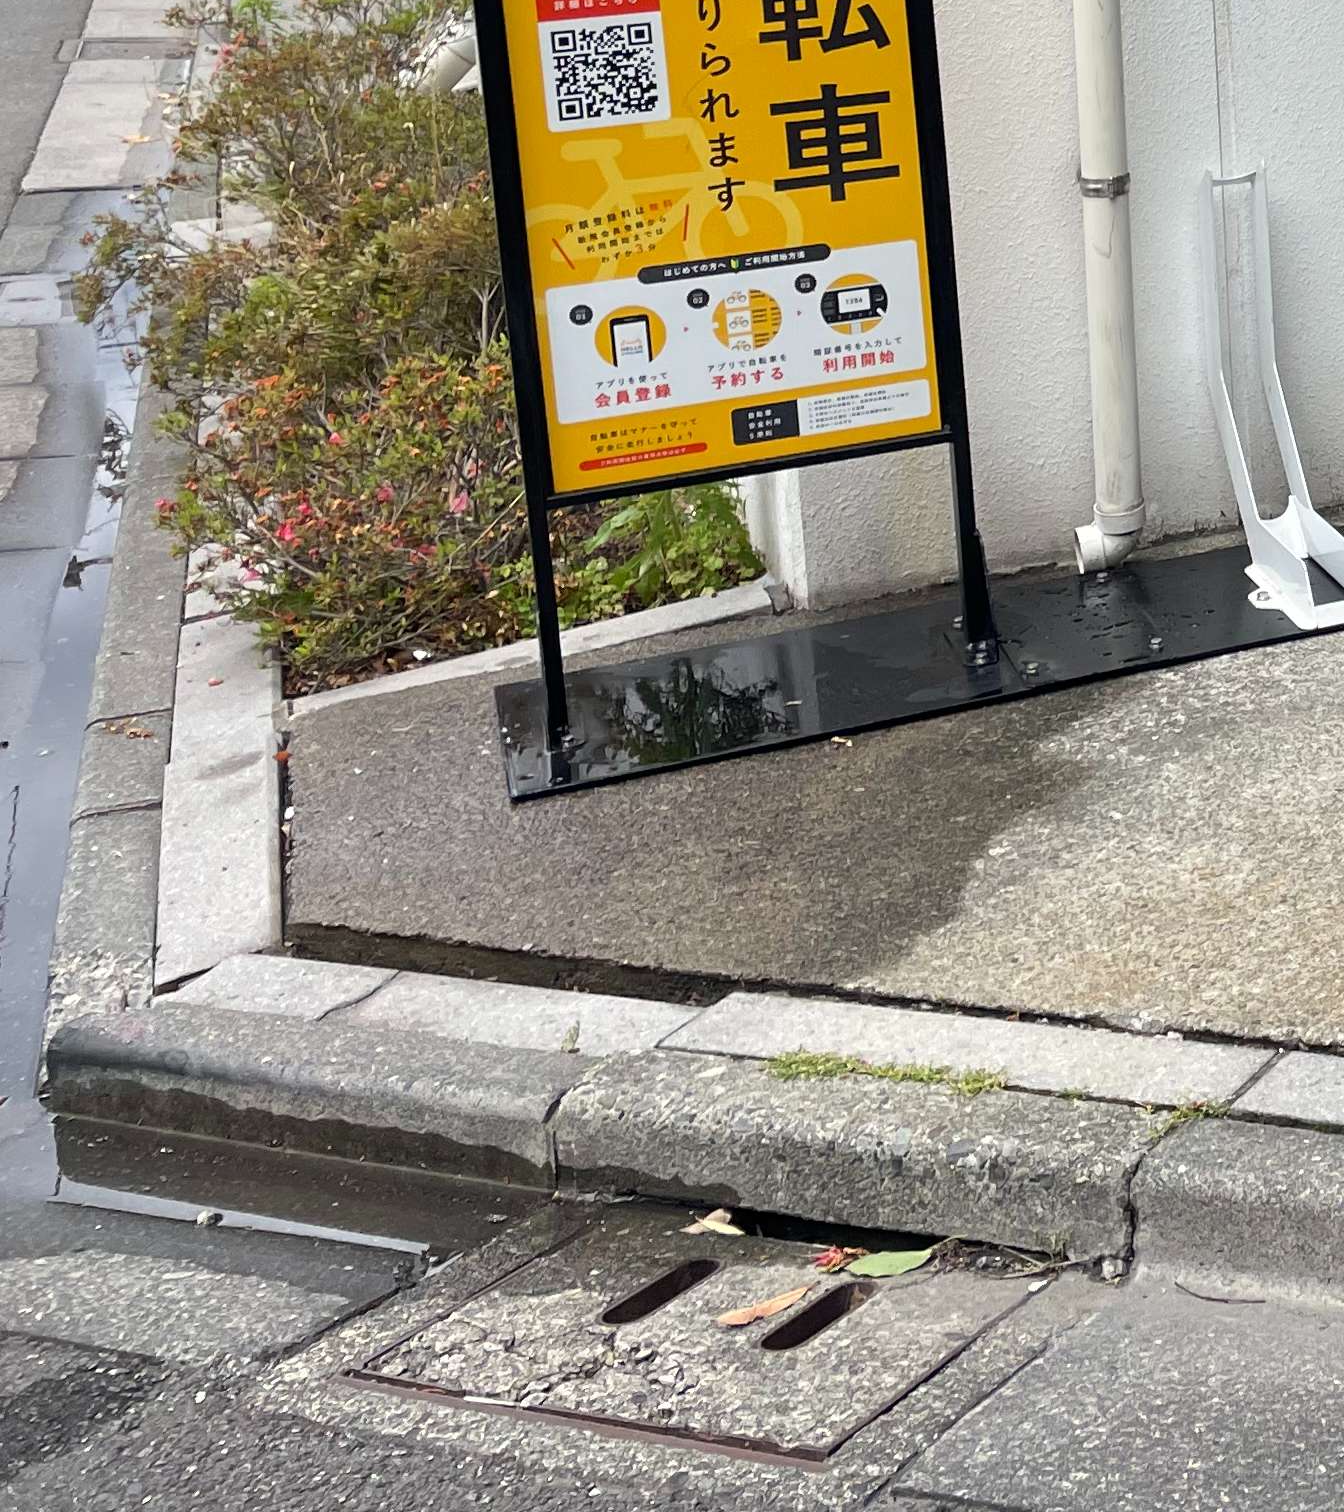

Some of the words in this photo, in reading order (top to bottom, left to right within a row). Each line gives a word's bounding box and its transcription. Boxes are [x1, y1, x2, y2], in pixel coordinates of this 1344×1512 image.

[663, 261, 727, 278] はじめての方へ
[706, 353, 787, 373] アプリで自転車を
[822, 349, 895, 373] 利用開始
[595, 371, 668, 389] アプリを使って
[711, 367, 785, 390] 予約する
[594, 383, 672, 408] 会員登録
